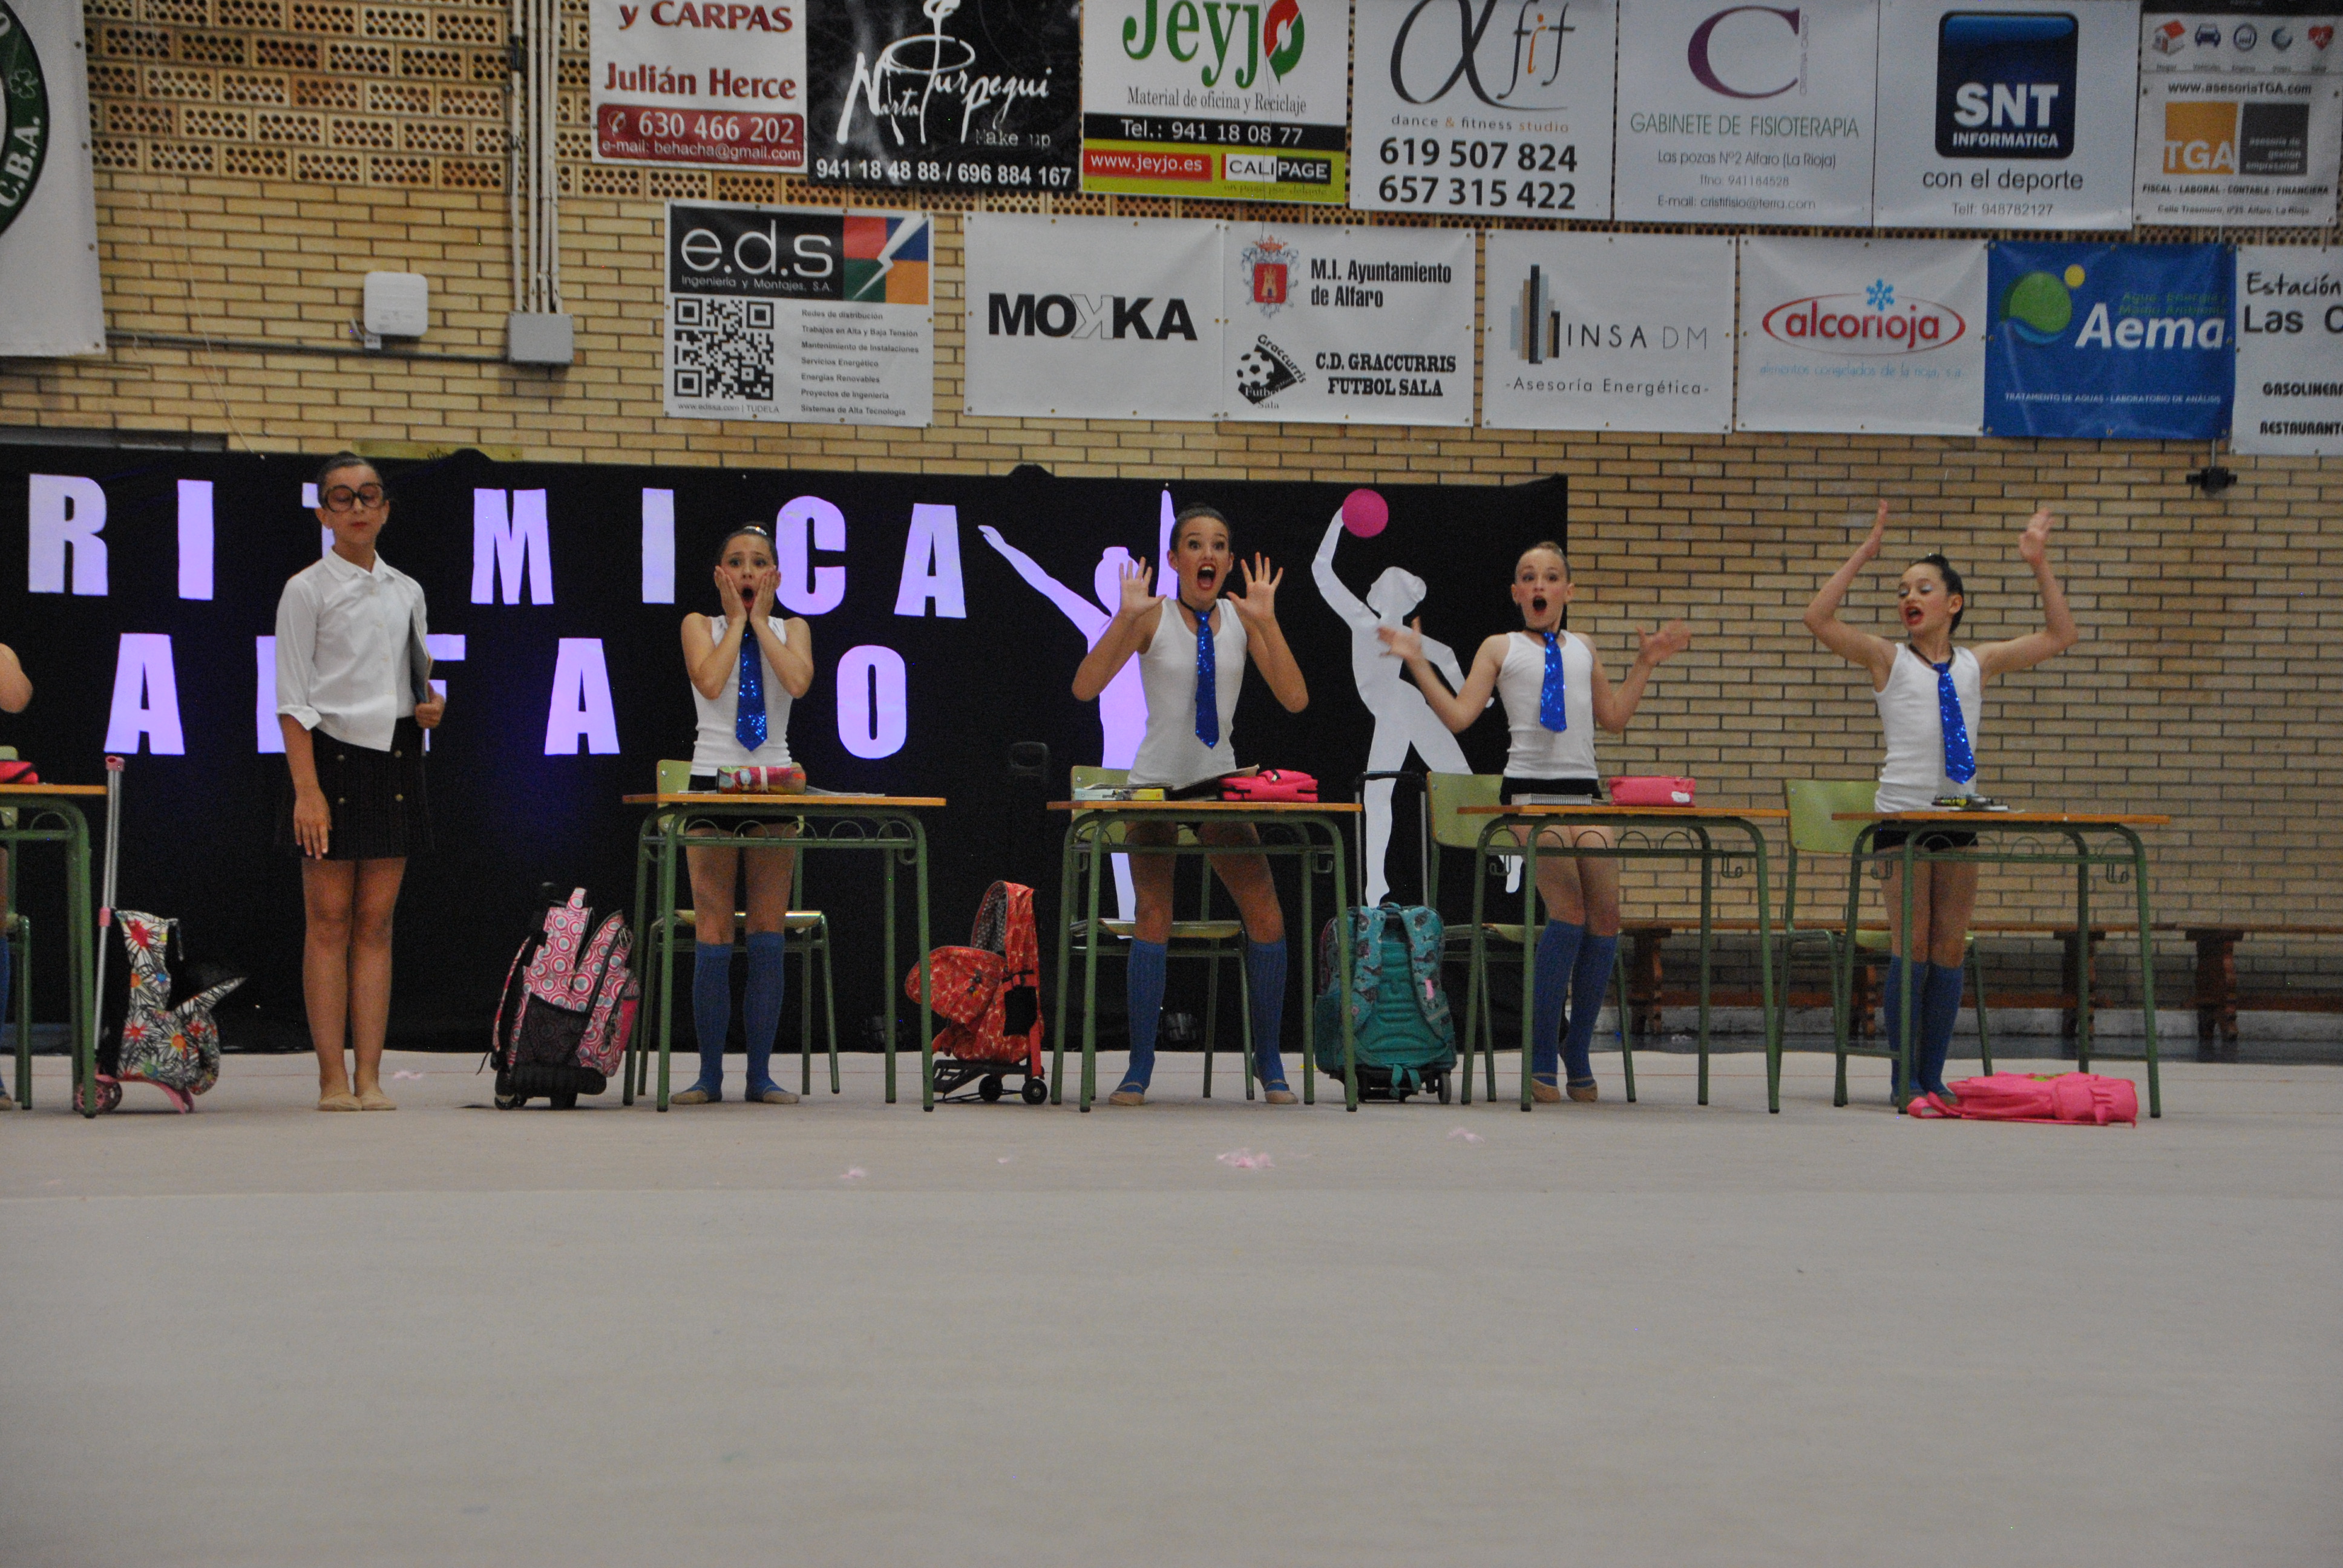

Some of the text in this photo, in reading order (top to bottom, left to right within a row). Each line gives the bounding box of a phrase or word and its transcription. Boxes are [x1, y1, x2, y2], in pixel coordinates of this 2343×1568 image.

[618, 1, 793, 33] y CARPAS
[1688, 5, 1800, 99] C
[605, 62, 796, 100] Julián Herce
[1128, 86, 1306, 116] Material de oficina y Reciclaje
[1953, 82, 2059, 128] SNT
[638, 111, 795, 144] 630 466 202
[1121, 119, 1303, 145] Tel.: 941 18 08 77
[1392, 114, 1438, 127] dance
[1462, 117, 1512, 131] fitness
[1519, 119, 1568, 132] studio
[1631, 113, 1712, 134] GABINETE
[1719, 116, 1740, 135] DE
[602, 140, 801, 160] e-mail: behacha@gmail.com
[1953, 131, 2058, 148] INFORMATICA
[1091, 154, 1202, 173] www.jeyjo.es
[1380, 137, 1577, 172] 619 507 824
[1658, 150, 1677, 163] Las
[1680, 153, 1715, 167] pozas
[1745, 152, 1779, 165] Alfaro
[1783, 152, 1800, 167] (La
[1803, 152, 1836, 169] Rioja)
[2165, 140, 2235, 170] TGA
[816, 158, 850, 179] 941
[859, 160, 881, 179] 18
[888, 160, 911, 180] 48
[918, 162, 940, 180] 88
[957, 163, 992, 182] 696
[998, 165, 1031, 184] 884
[1040, 166, 1071, 186] 167
[1922, 168, 2083, 194] con el deporte
[1379, 174, 1575, 209] 657 315 422
[1311, 258, 1452, 284] M.I. Ayuntamiento
[2247, 272, 2341, 295] Estación
[1311, 286, 1383, 307] de Alfaro
[839, 310, 883, 319] distribución
[1786, 299, 1939, 349] alcorioja
[2074, 302, 2226, 350] Aema
[2244, 304, 2304, 333] Las
[802, 325, 833, 335] Trabajos
[1568, 323, 1708, 350] INSA DM
[802, 341, 856, 350] Mantenimiento
[870, 344, 919, 353] Instalaciones
[1257, 334, 1306, 384] Graccurris
[1316, 352, 1457, 373] C.D. GRACCURRIS
[836, 374, 880, 383] Renovables
[1328, 376, 1443, 397] FUTBOL SALA
[747, 404, 779, 413] TUDELA
[801, 404, 834, 413] Sistemas
